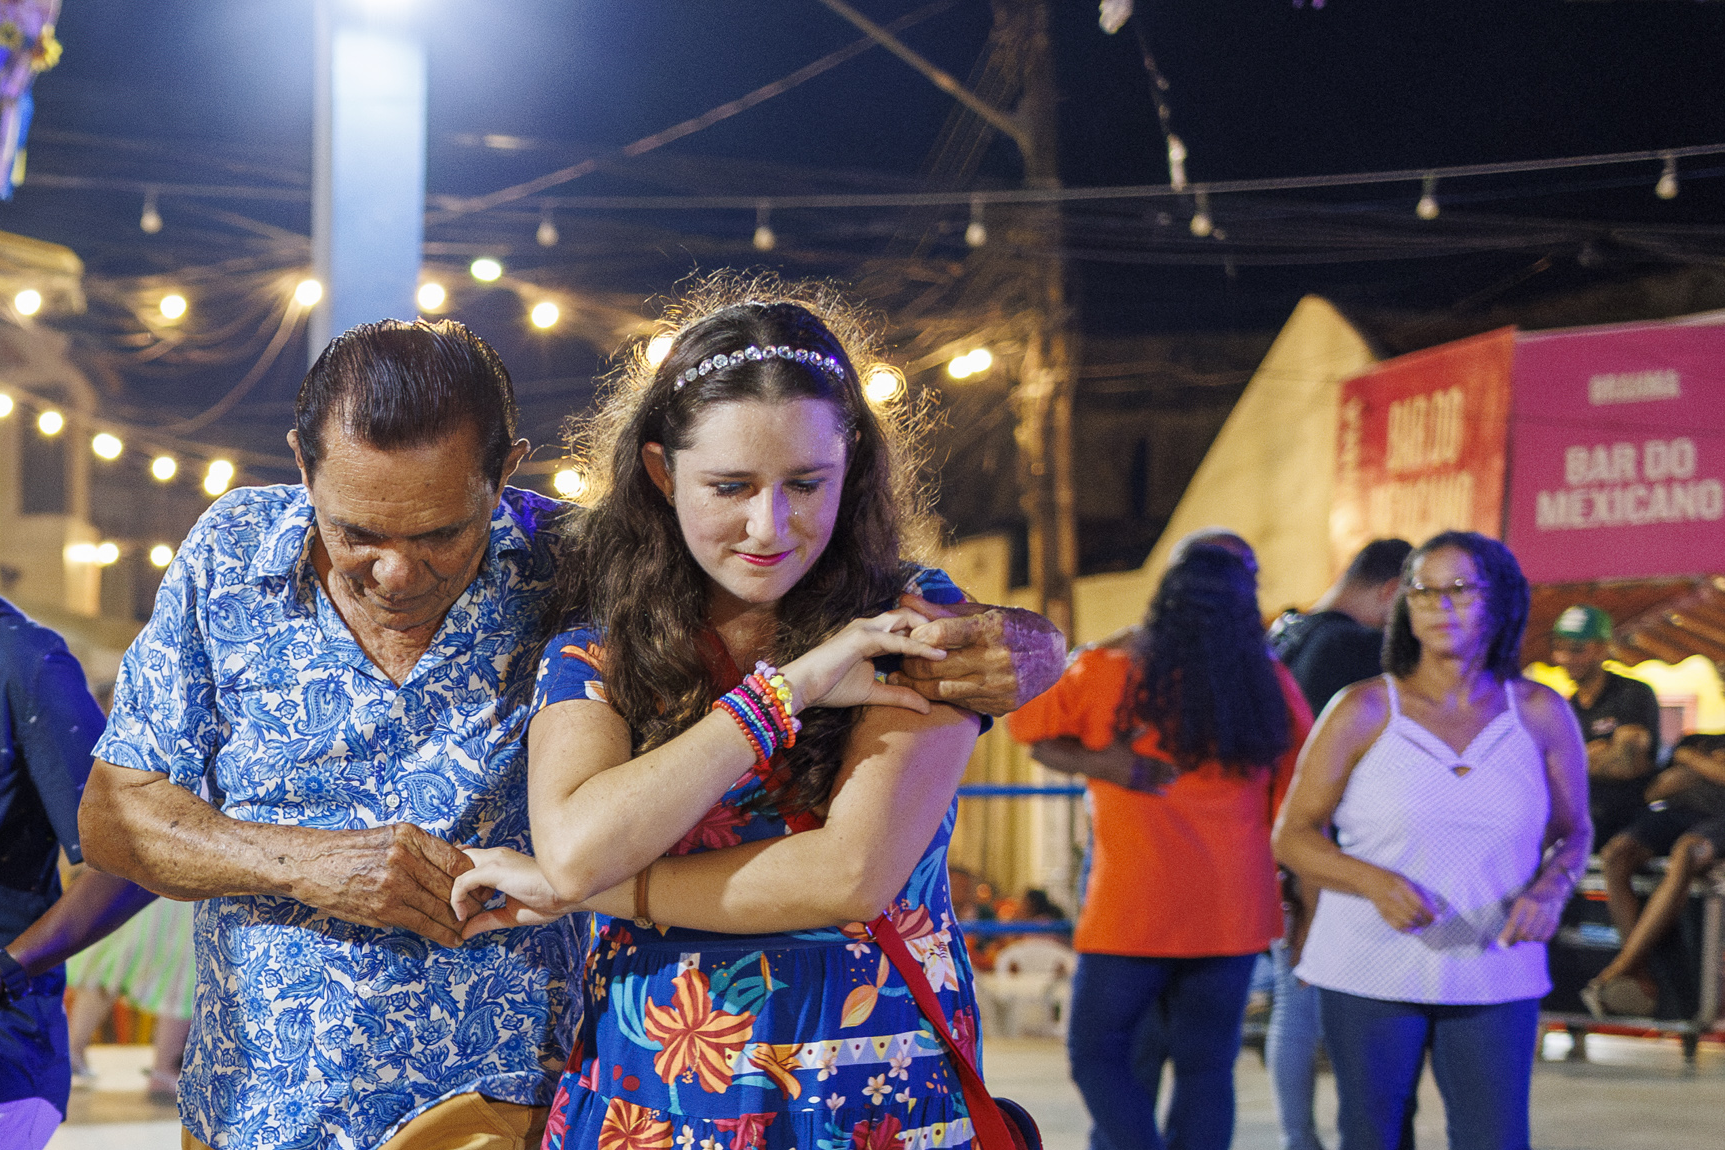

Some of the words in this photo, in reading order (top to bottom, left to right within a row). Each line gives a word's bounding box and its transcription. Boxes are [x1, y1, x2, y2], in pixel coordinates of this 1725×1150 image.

[1564, 441, 1638, 488] BAR
[1642, 437, 1698, 481] DO
[1535, 478, 1723, 532] MEXICANO
